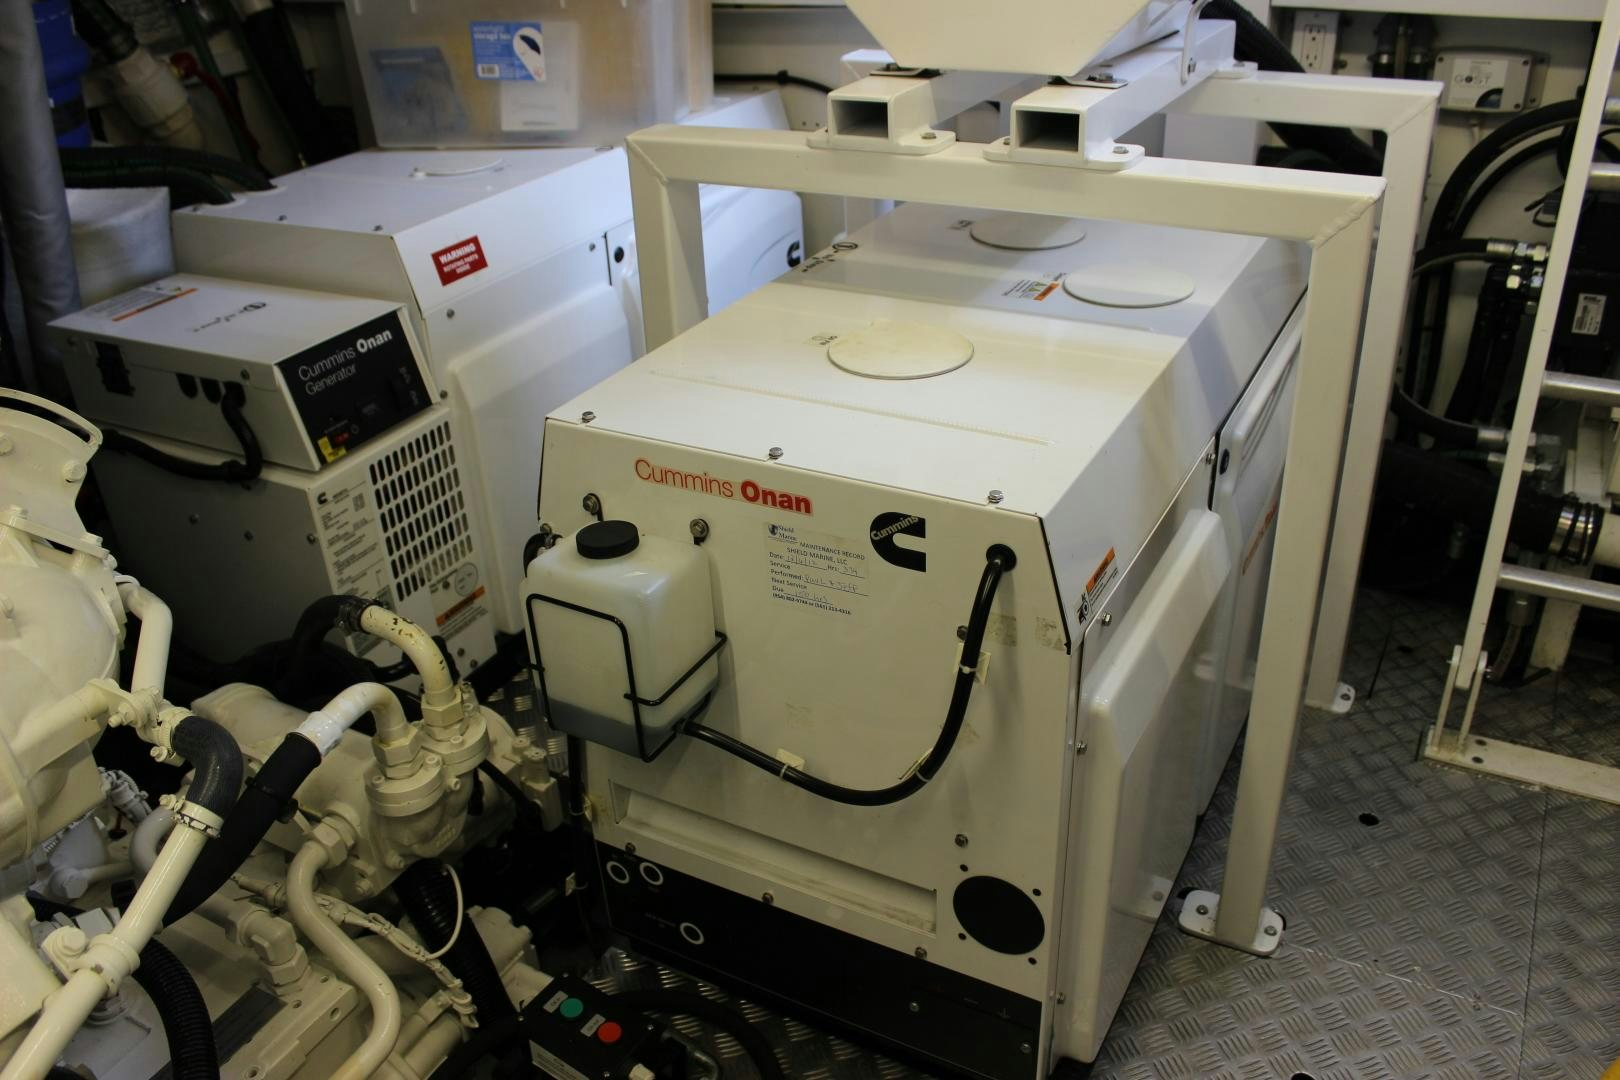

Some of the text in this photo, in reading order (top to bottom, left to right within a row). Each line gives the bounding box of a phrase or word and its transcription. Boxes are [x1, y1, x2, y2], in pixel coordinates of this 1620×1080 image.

[439, 242, 476, 265] WARNING
[298, 329, 393, 381] Cummins Onan
[305, 363, 357, 396] Generator
[634, 458, 813, 514] Cummins Onan
[870, 514, 919, 542] Cummins
[799, 541, 842, 556] MAINTENANCE
